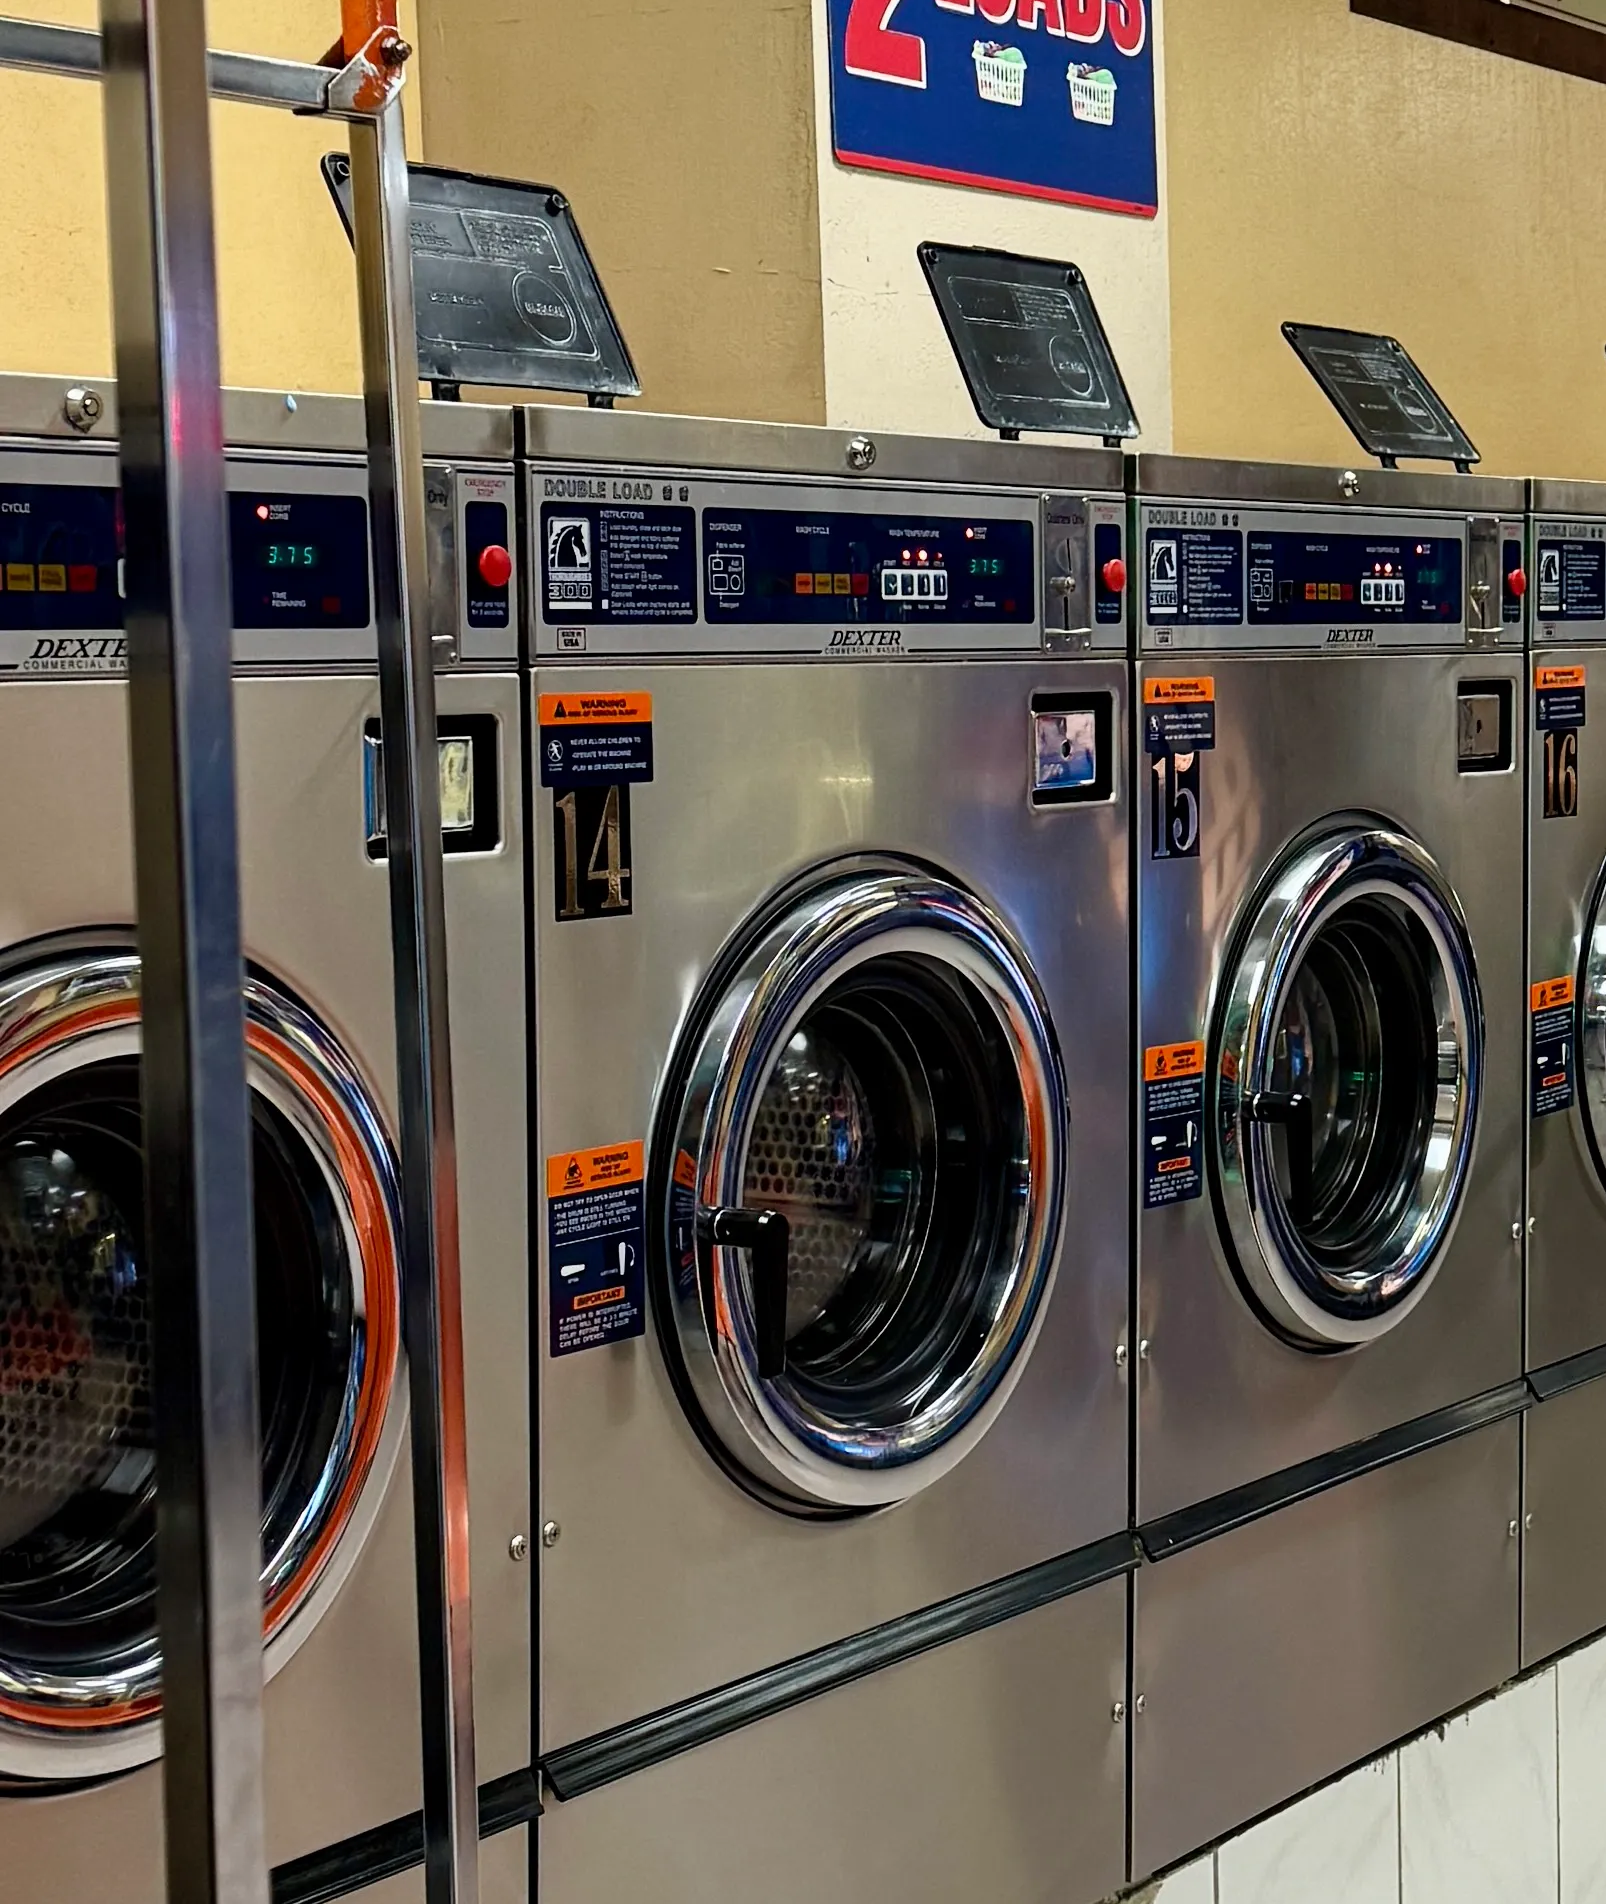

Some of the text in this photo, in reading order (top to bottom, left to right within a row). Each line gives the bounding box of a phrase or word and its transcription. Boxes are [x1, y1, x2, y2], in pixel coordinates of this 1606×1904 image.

[544, 478, 653, 501] DOUBLE LOAD
[427, 490, 449, 507] Only
[1148, 509, 1216, 526] DOUBLE LOAD
[268, 546, 313, 565] 3.75
[829, 630, 901, 646] DEXTER
[1326, 629, 1374, 643] DEXTER
[29, 639, 128, 658] DEXTE
[824, 647, 872, 655] COMMERCIAL
[23, 660, 104, 670] COMMERCIAL
[580, 699, 626, 710] WARNING
[1545, 733, 1577, 816] 16
[1152, 752, 1198, 857] 15
[556, 785, 630, 916] 14
[593, 1151, 628, 1166] WARNING
[577, 1288, 622, 1306] IMPORTANT
